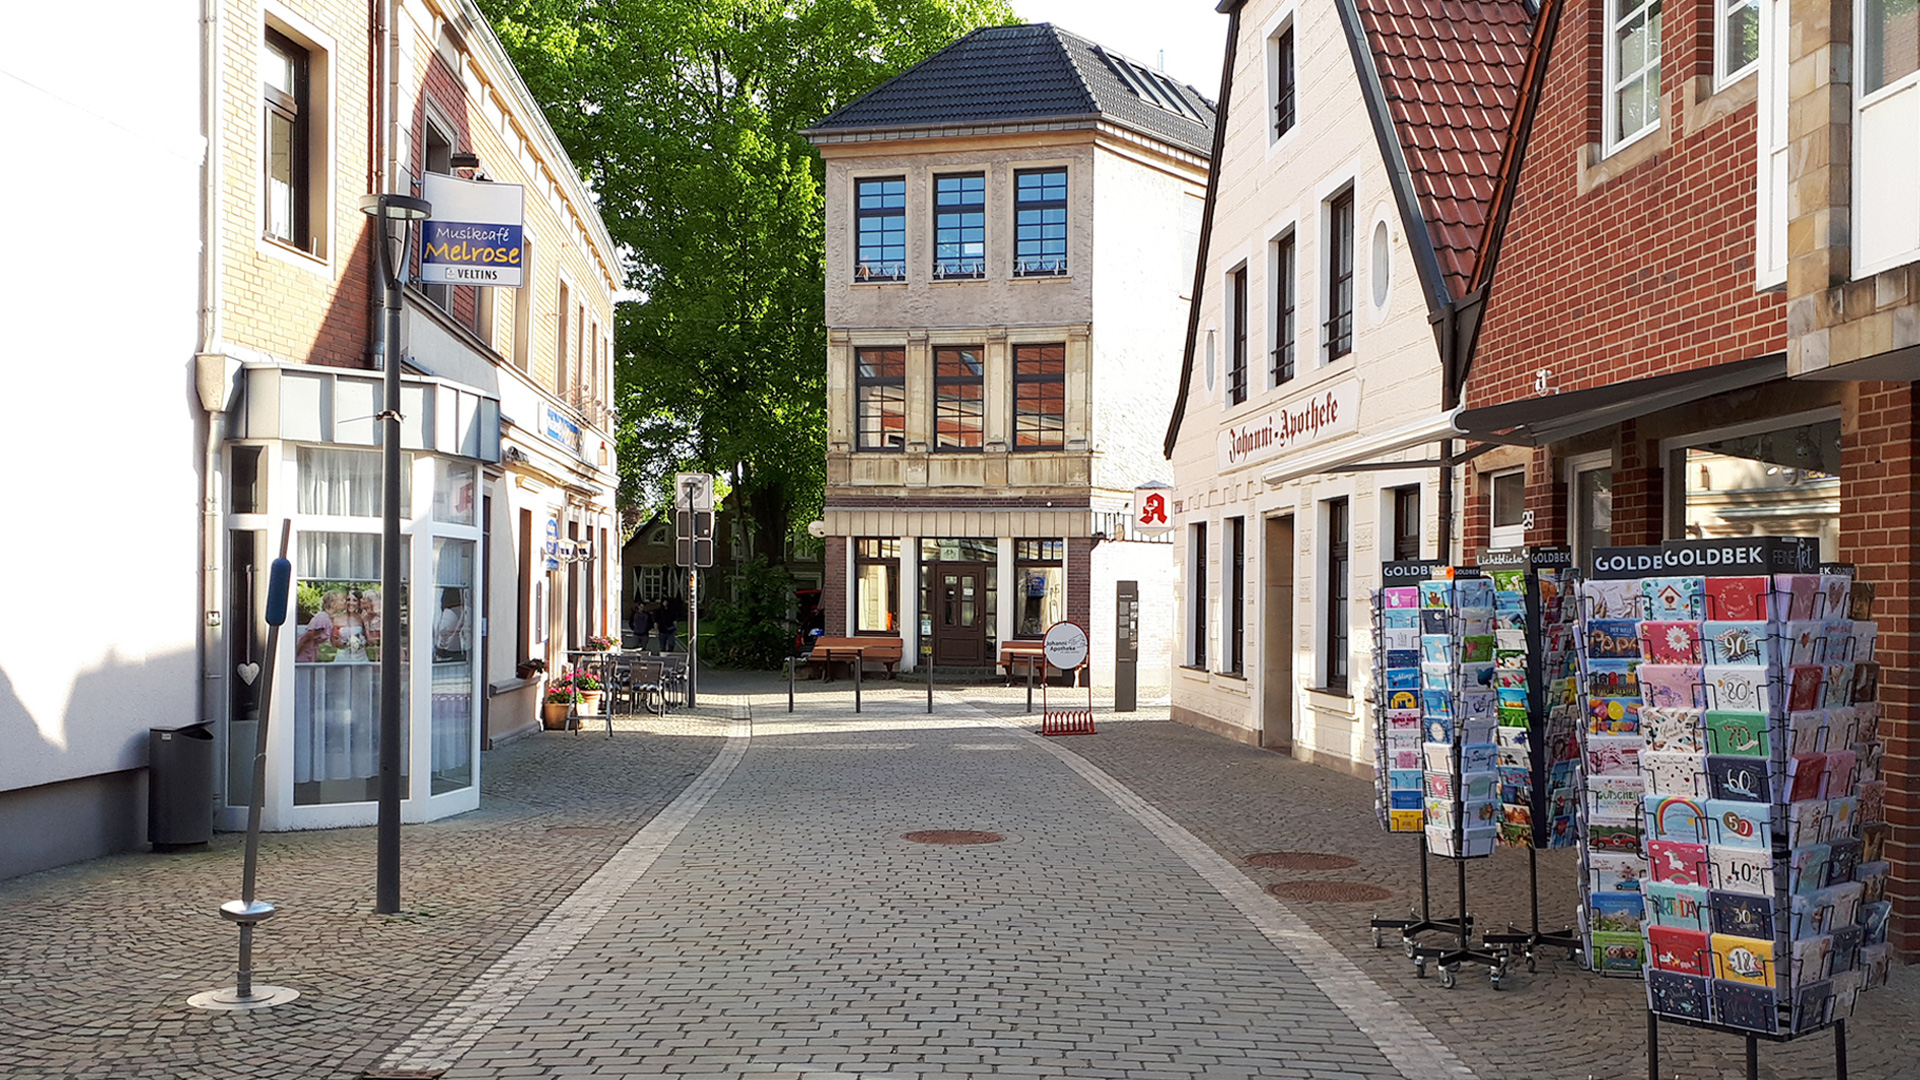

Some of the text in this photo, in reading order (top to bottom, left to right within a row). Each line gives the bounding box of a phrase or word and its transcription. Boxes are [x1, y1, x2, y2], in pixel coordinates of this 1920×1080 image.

[436, 226, 510, 244] Musikcafé
[424, 241, 520, 264] Melrose
[457, 269, 498, 280] VELTINS
[1476, 553, 1524, 566] Lichtblicke
[1531, 552, 1571, 563] GOLDBEK
[1595, 555, 1662, 571] GOLDB
[1664, 546, 1763, 566] GOLDBEK
[1724, 636, 1747, 657] 90
[1726, 681, 1748, 700] 80
[1723, 725, 1751, 748] 70
[1727, 768, 1750, 791] 60
[1728, 815, 1748, 835] 50
[1731, 861, 1751, 882] 40
[1733, 908, 1751, 924] 30
[1735, 951, 1751, 971] 18
